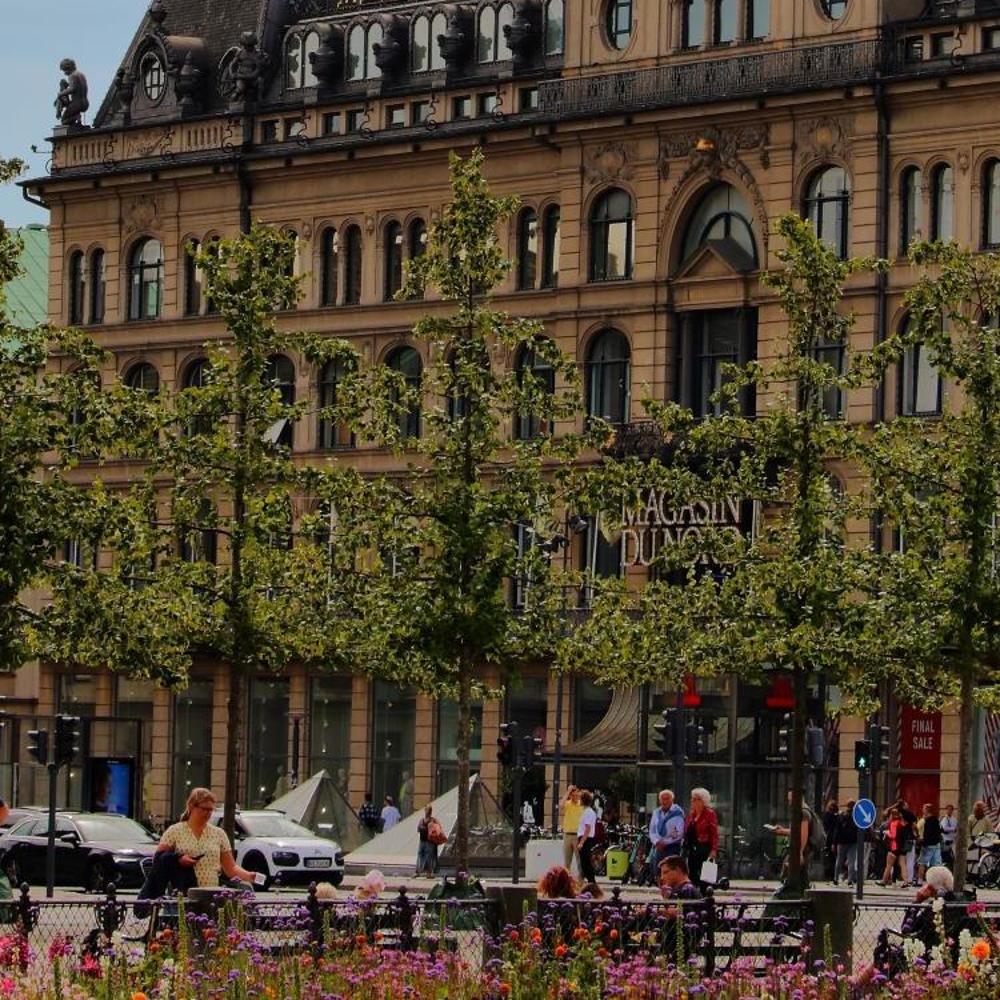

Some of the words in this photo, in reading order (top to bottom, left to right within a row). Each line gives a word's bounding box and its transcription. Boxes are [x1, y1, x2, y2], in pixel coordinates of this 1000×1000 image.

[621, 485, 743, 526] MAGASIN
[912, 719, 935, 734] FINAL
[912, 737, 933, 750] SALE
